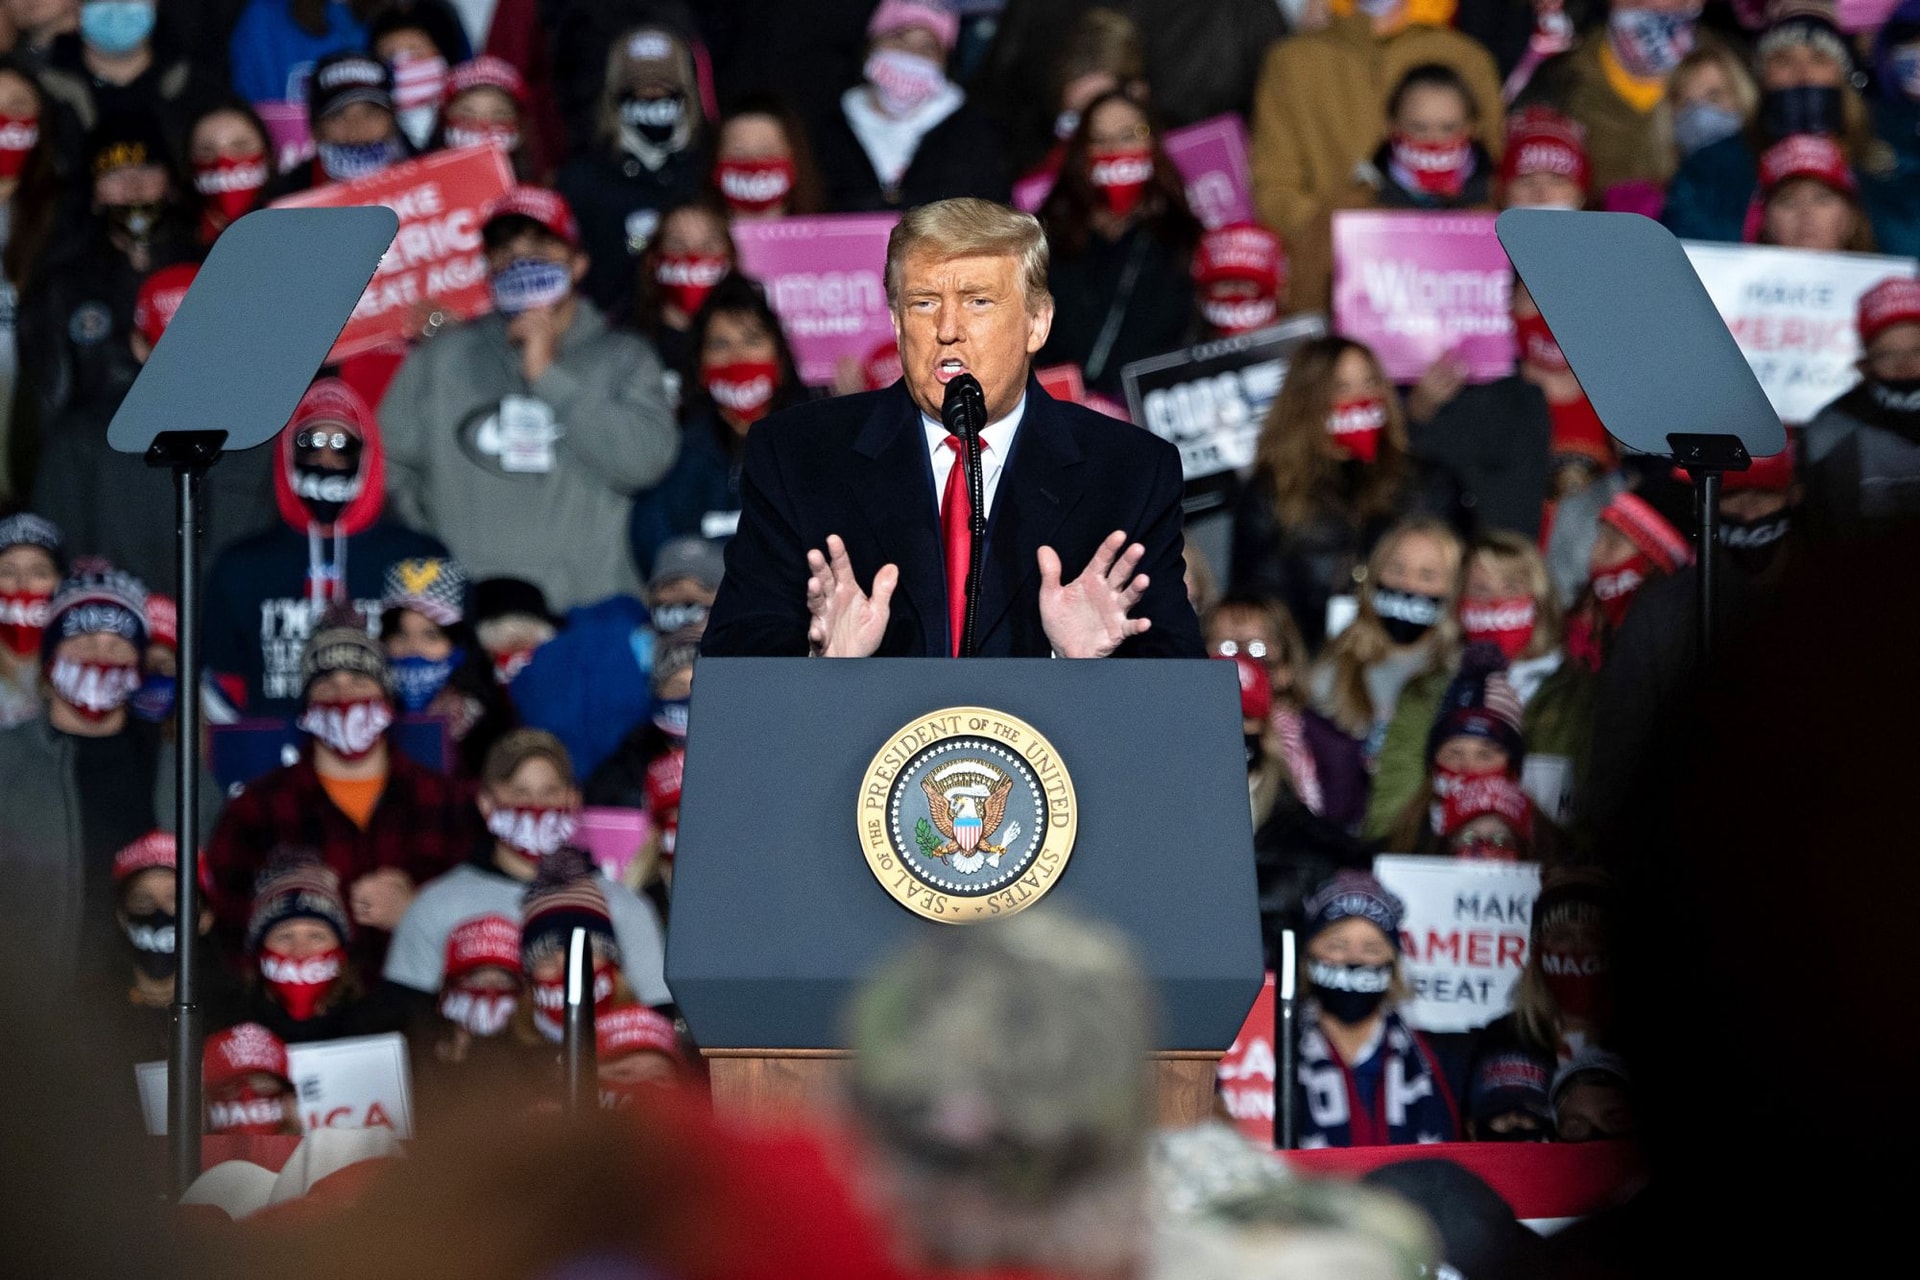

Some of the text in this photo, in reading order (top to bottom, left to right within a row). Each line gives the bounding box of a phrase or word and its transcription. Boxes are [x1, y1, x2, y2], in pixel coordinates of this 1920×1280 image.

[376, 209, 483, 275] ERIC
[763, 268, 884, 316] men
[1362, 258, 1512, 314] Wome
[1726, 316, 1856, 352] MERIC
[866, 715, 1069, 914] SEAL OF THE PRESIDENT OF THE UNITED STATES
[1454, 890, 1529, 924] MAK
[1398, 928, 1529, 969] AMER
[1542, 952, 1602, 977] MAG
[1411, 977, 1491, 1005] REAT
